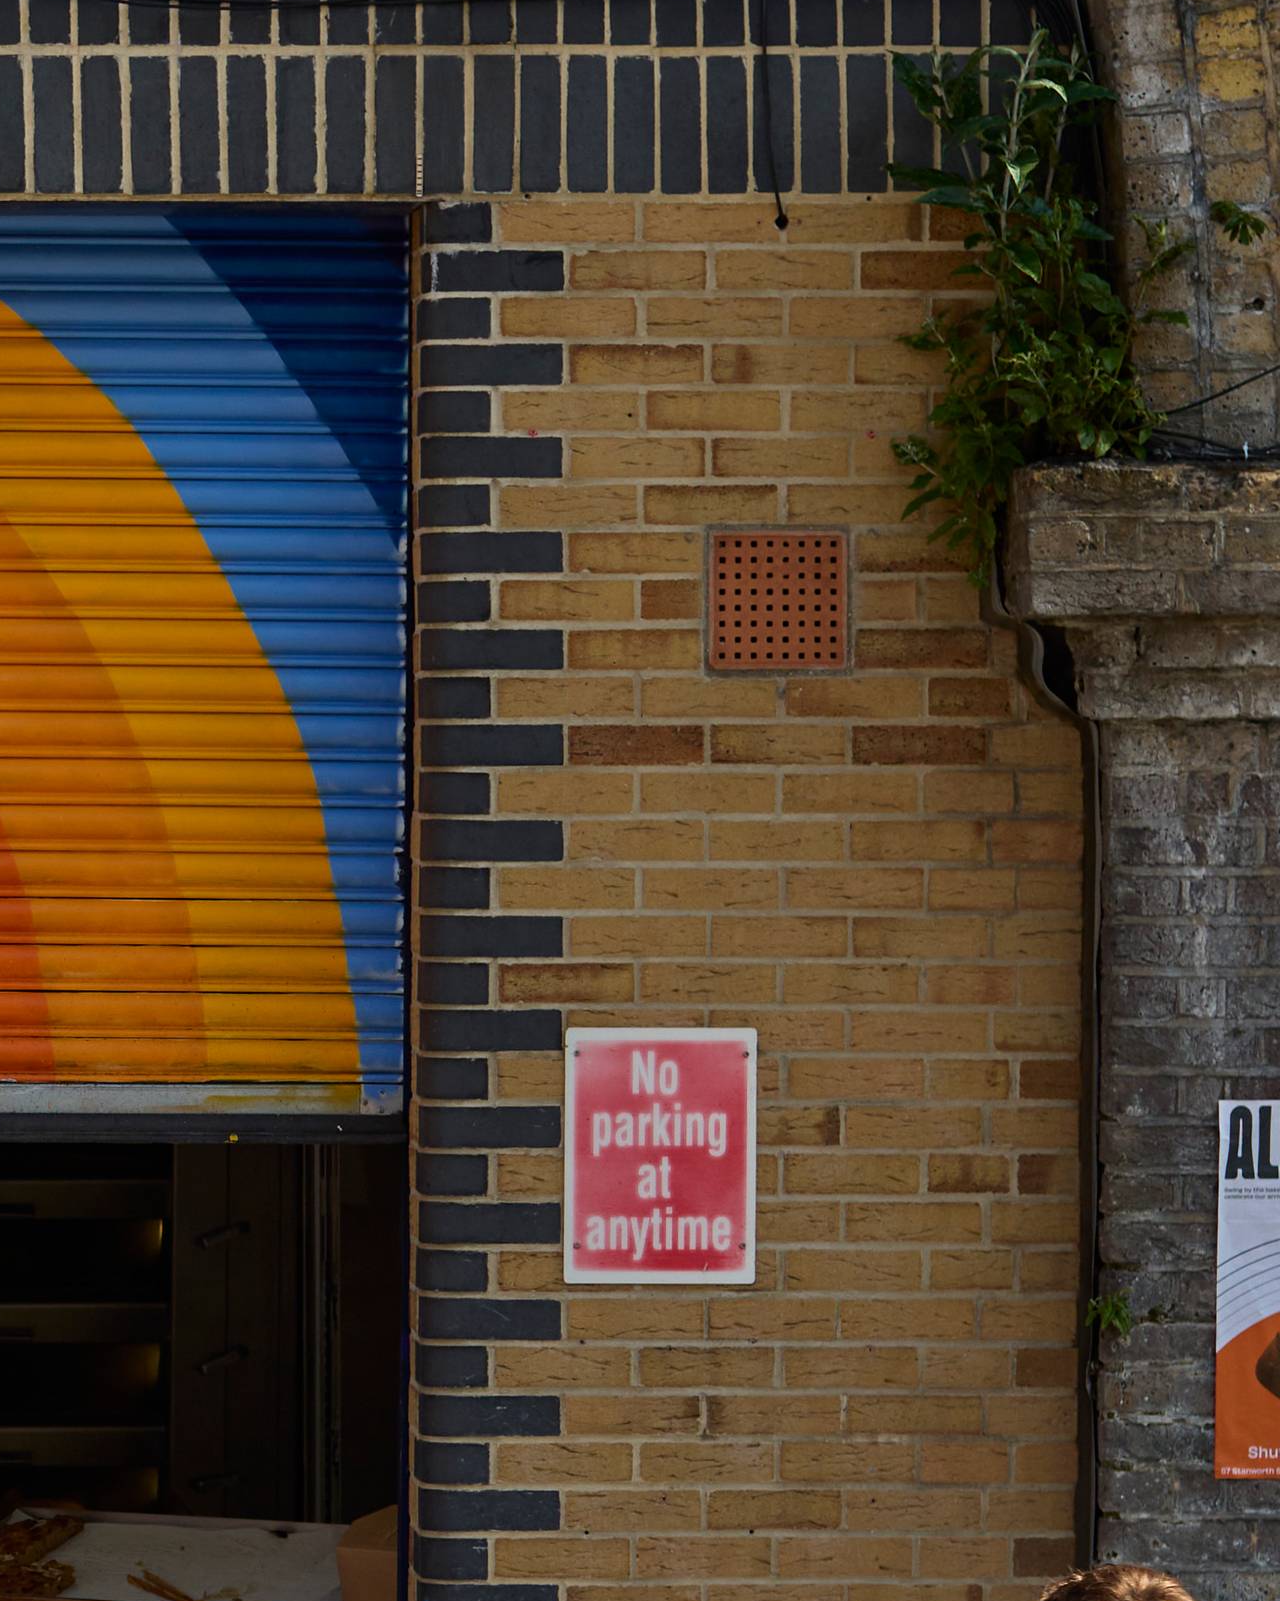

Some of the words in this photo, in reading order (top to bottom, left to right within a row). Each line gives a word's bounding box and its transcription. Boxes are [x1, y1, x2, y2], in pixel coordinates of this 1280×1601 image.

[632, 1050, 679, 1096] No
[592, 1103, 728, 1157] parking
[637, 1156, 672, 1199] at
[586, 1206, 732, 1261] anytime
